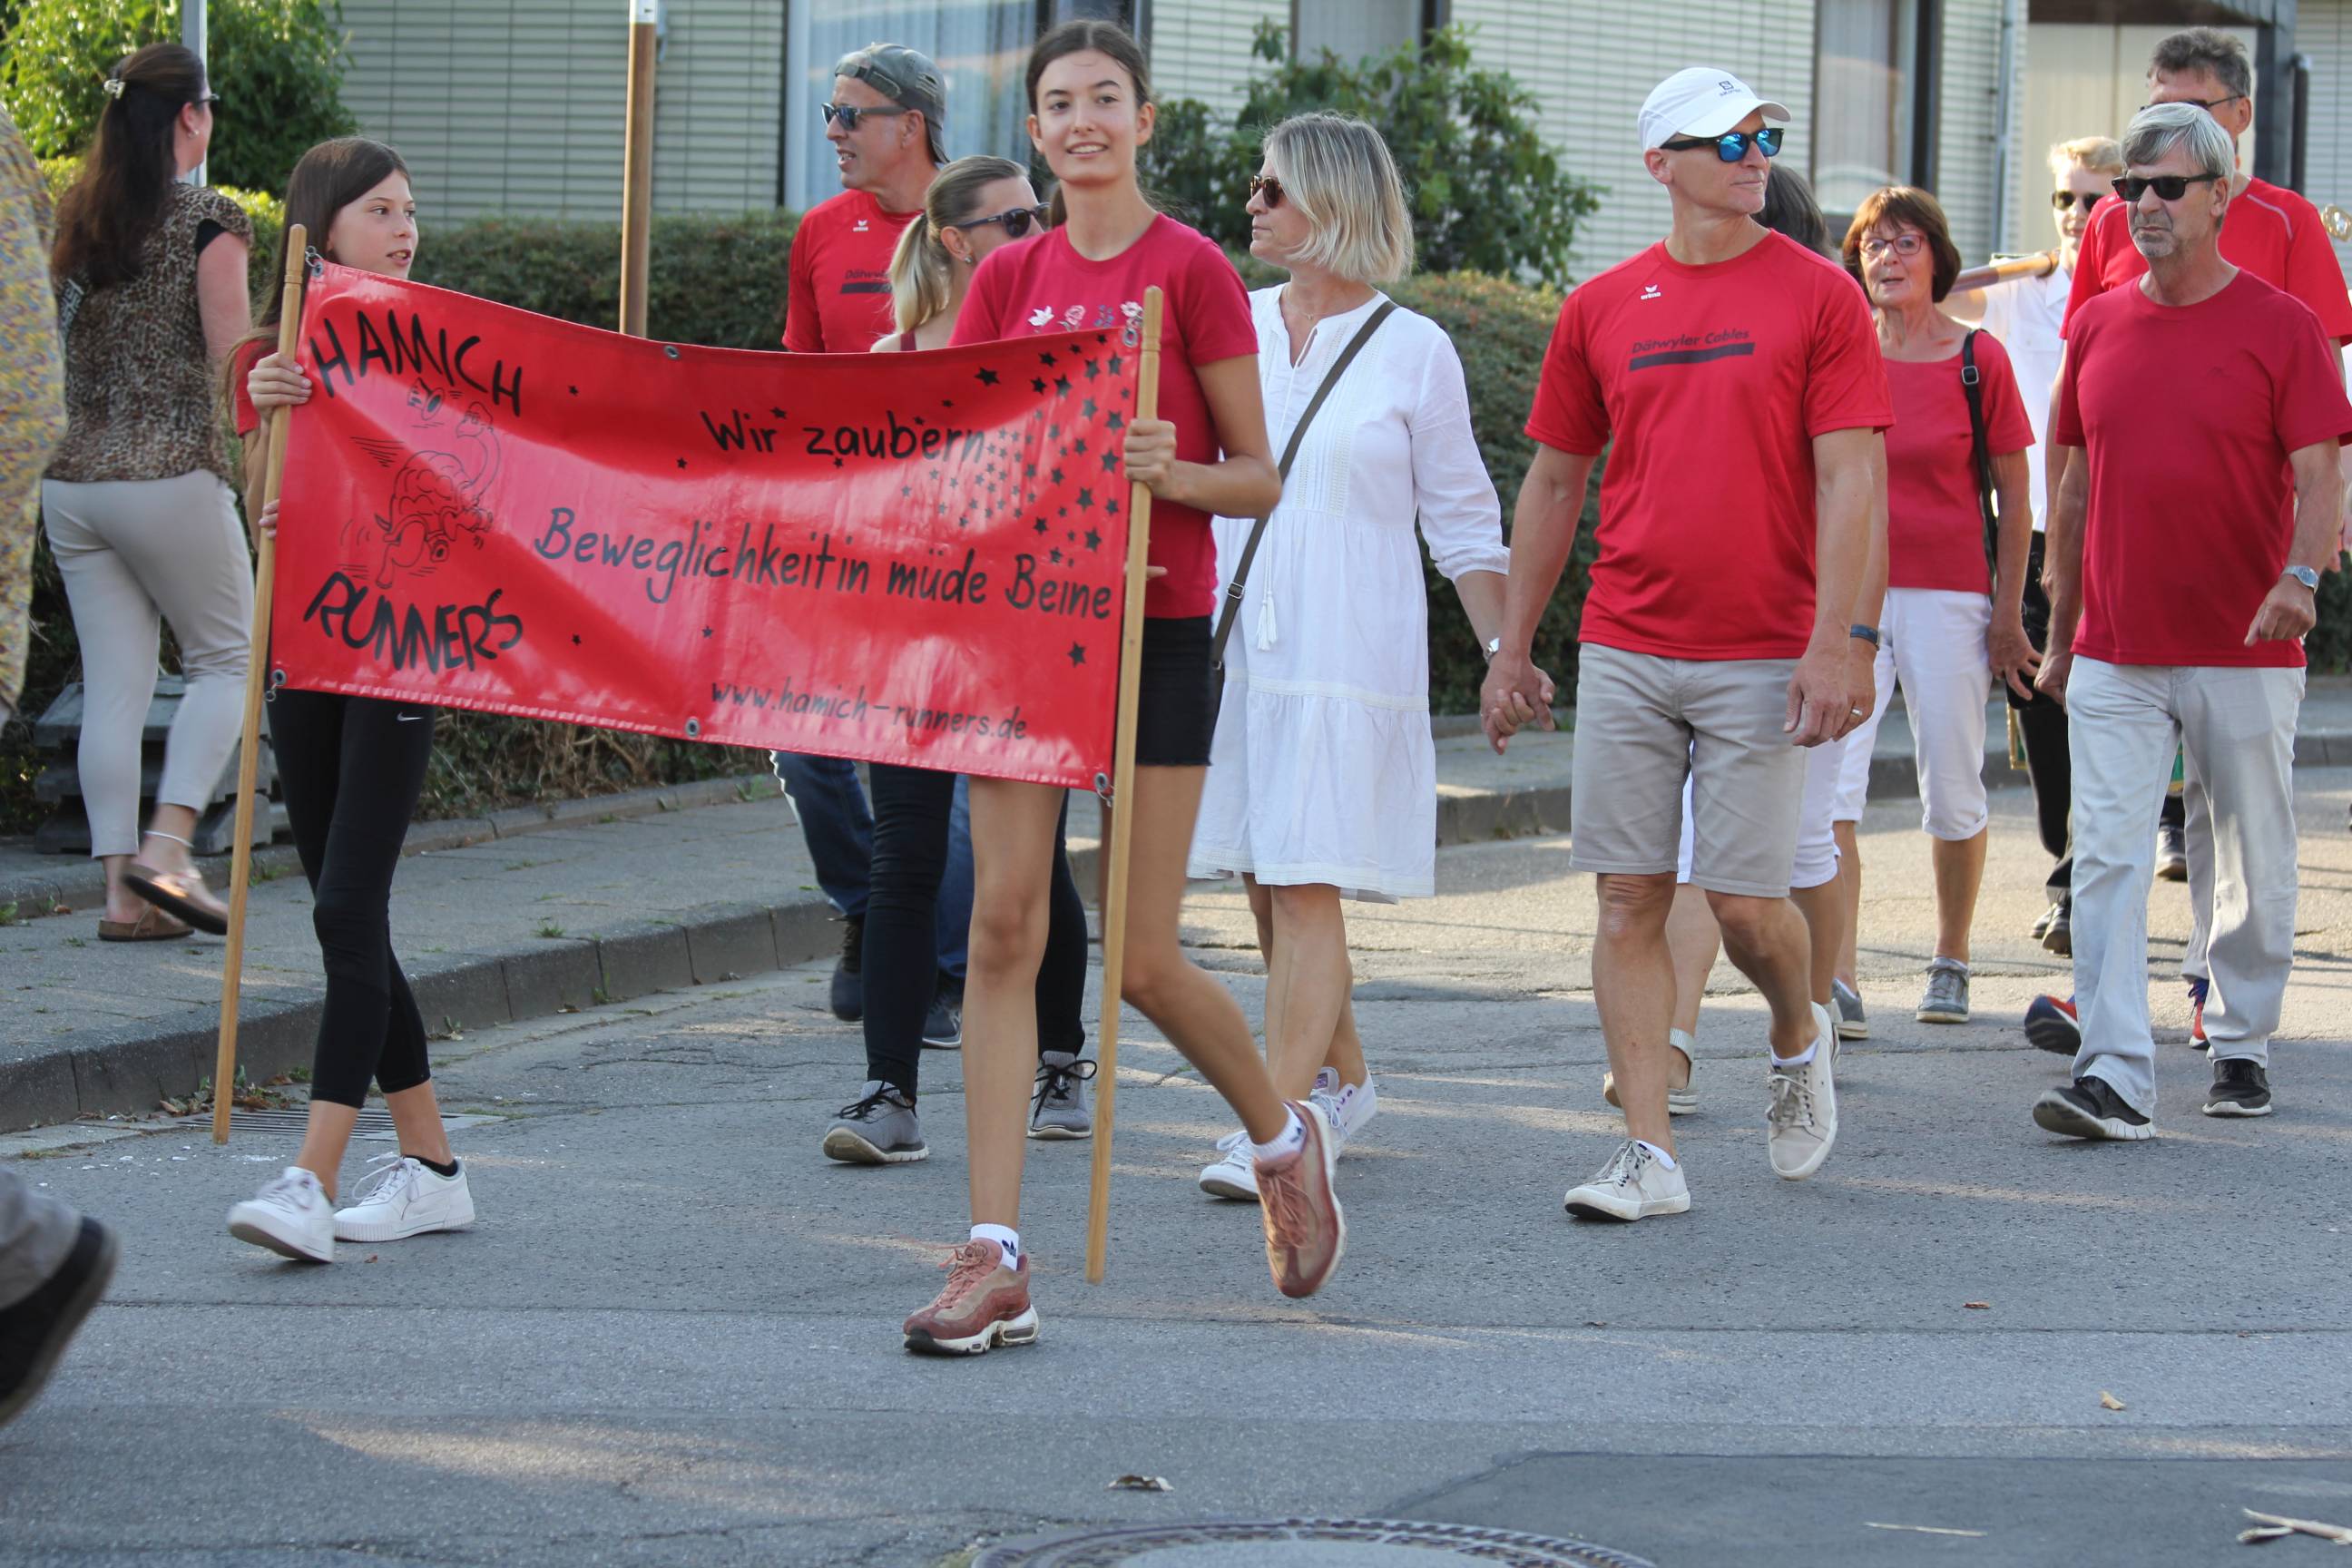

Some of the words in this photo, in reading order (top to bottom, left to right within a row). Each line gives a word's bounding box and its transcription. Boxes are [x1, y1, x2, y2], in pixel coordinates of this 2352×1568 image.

[309, 309, 522, 416] HAMICH
[1704, 328, 1750, 344] Cables
[700, 409, 778, 453] Wir
[802, 410, 985, 463] zaubern
[887, 548, 988, 604] müde
[1004, 553, 1112, 621] Beine
[303, 571, 524, 674] RUNNERS
[710, 676, 1027, 740] www.hamich-runners.de
